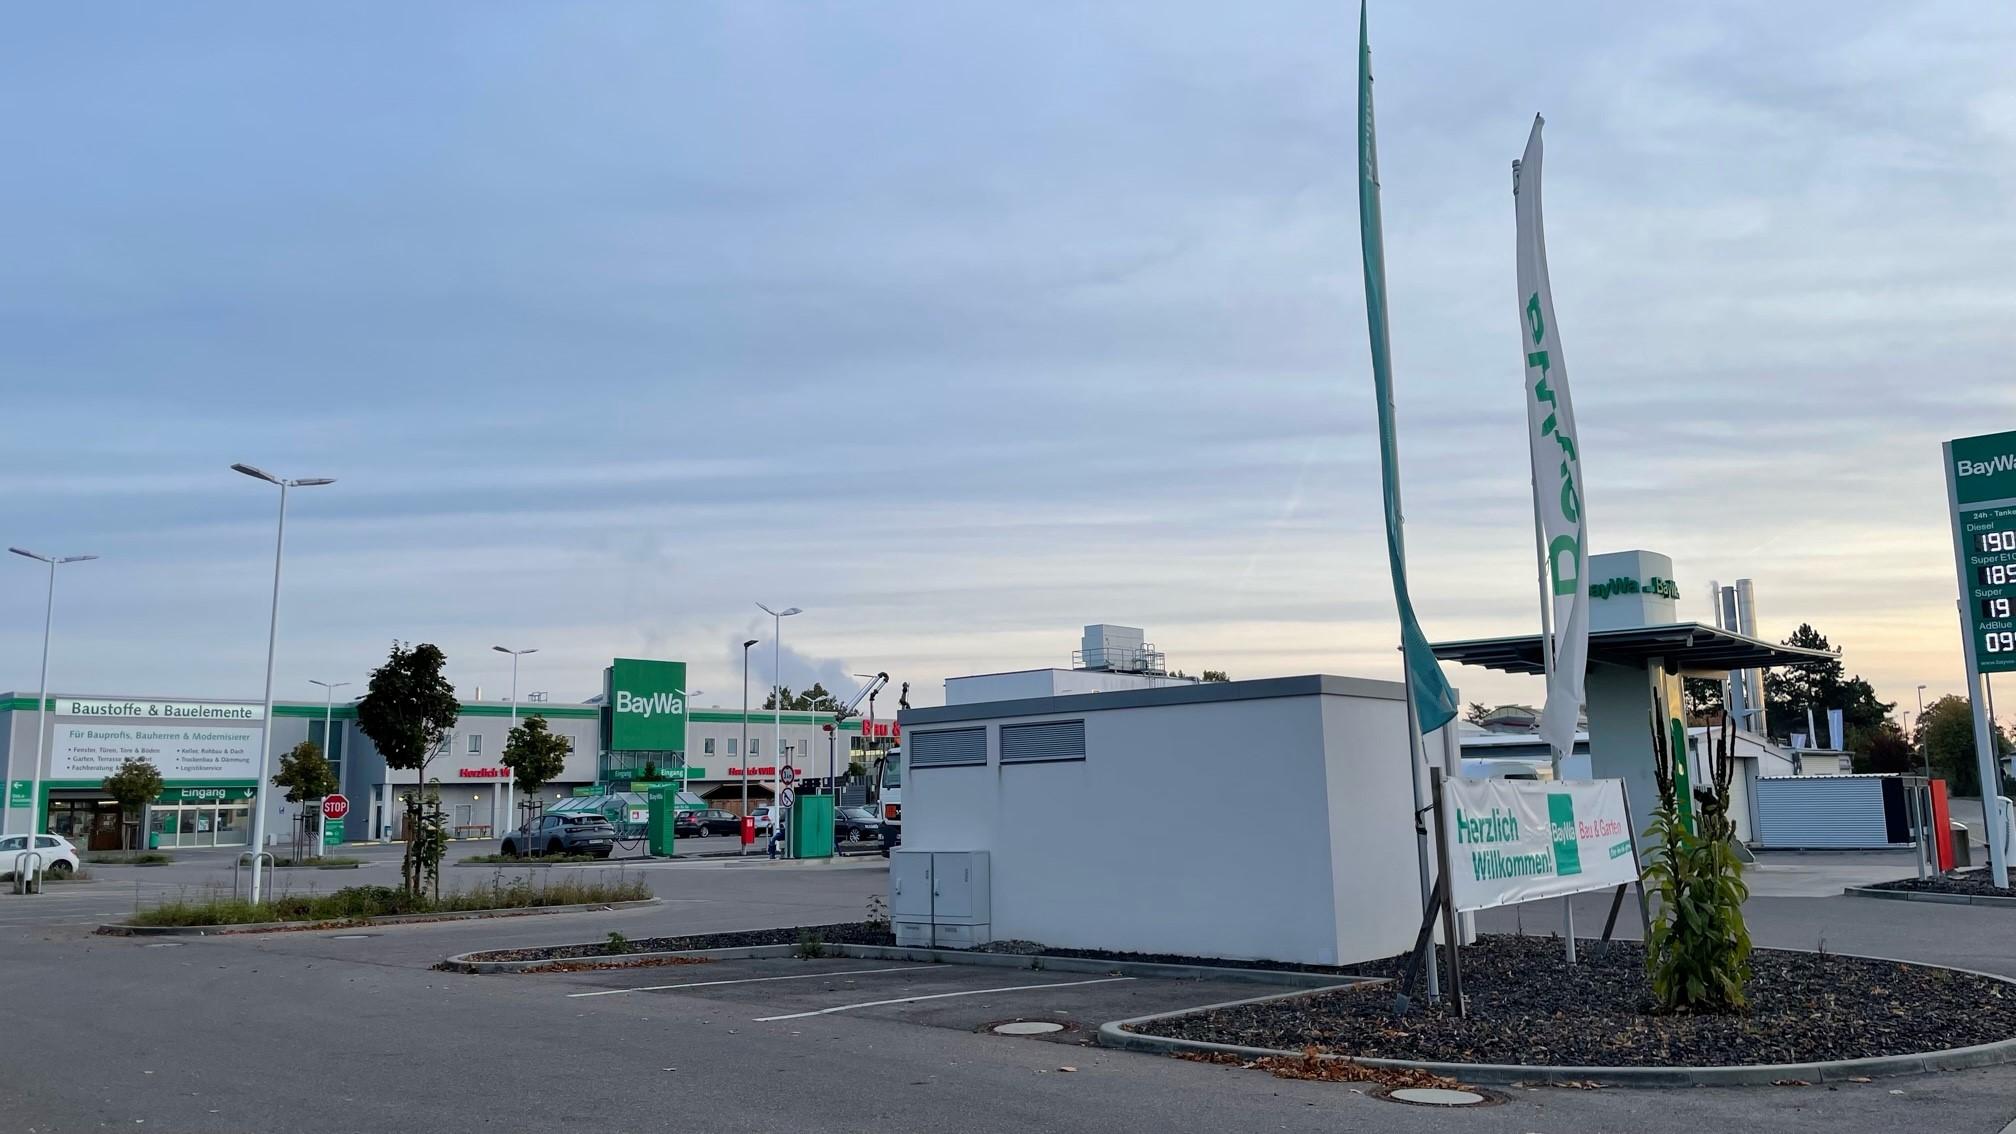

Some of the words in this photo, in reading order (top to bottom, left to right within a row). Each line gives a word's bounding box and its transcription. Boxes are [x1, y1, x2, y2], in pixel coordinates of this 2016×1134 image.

[1957, 454, 2016, 476] BayW
[1966, 522, 1994, 532] Diesel
[1982, 531, 2016, 552] 190
[1971, 556, 1998, 565] Super
[1589, 577, 1640, 600] ayWa
[1975, 588, 2003, 598] Super
[1979, 621, 2013, 631] AdBlue
[71, 702, 142, 715] Baustoffe
[148, 704, 159, 716] &
[164, 704, 252, 718] Bauelemente
[616, 690, 682, 718] BayWa
[69, 730, 84, 738] Für
[136, 731, 180, 740] Bauherren
[183, 732, 189, 740] &
[192, 732, 250, 741] Modernisierer
[661, 769, 684, 778] Eingang
[181, 788, 226, 799] Eingang
[324, 802, 347, 812] STOP
[1456, 808, 1519, 844] Herzlich
[1578, 821, 1593, 840] Bau
[1594, 820, 1600, 837] &
[1600, 819, 1622, 836] Garten
[1472, 846, 1552, 881] Willkommen!
